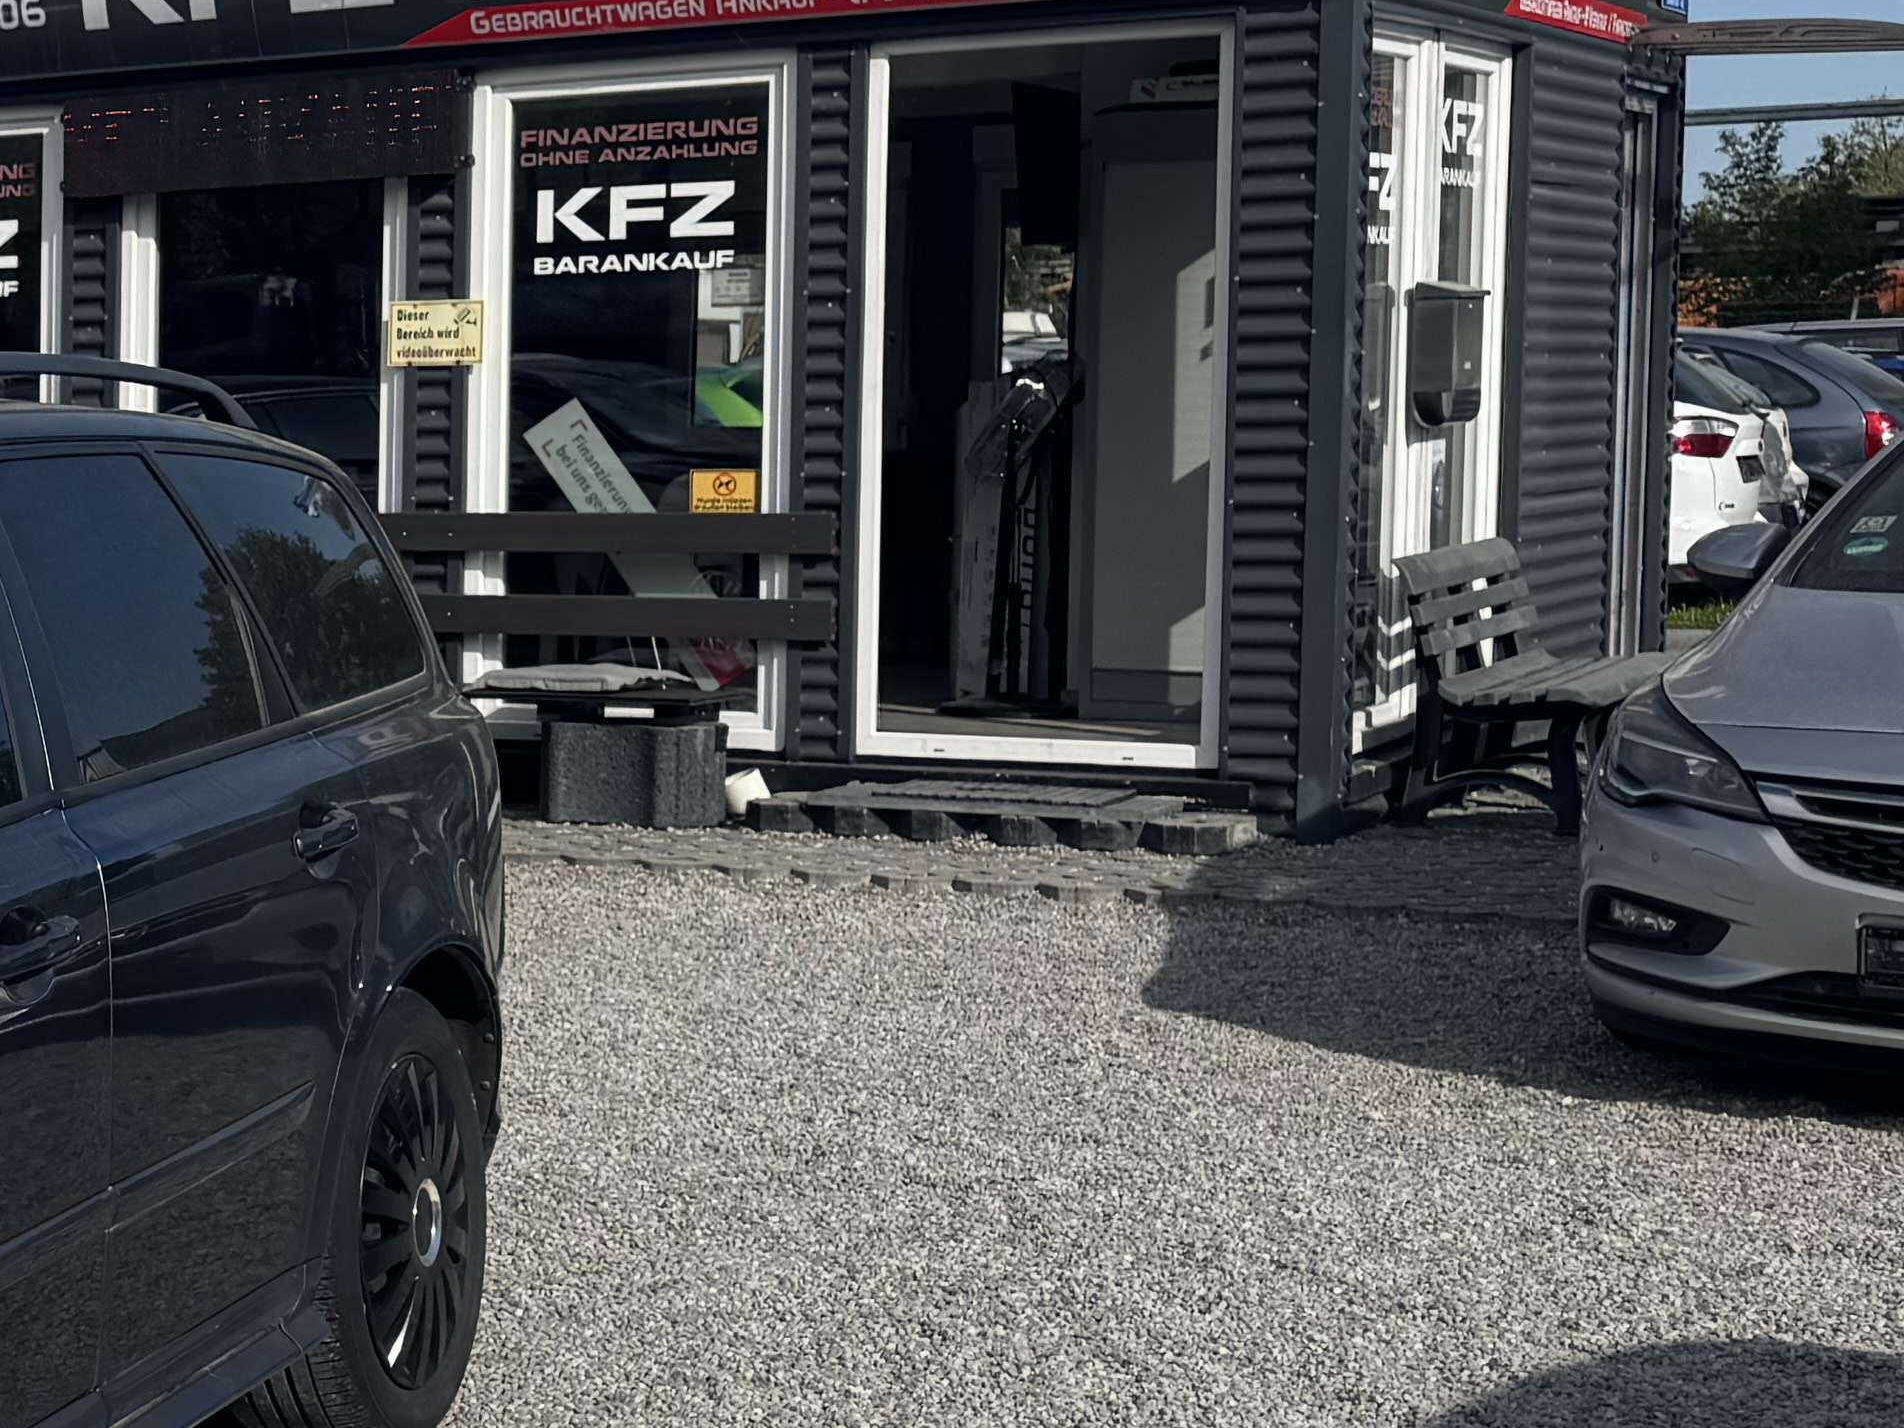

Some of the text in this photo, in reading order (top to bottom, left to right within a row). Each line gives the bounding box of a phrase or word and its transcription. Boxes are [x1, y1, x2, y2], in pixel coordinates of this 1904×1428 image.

[520, 116, 759, 149] FINANZIERUNG
[520, 139, 758, 168] OHNE ANZAHLUNG
[536, 180, 735, 243] KFZ
[533, 249, 735, 276] BARANKAUF
[397, 309, 430, 322] Dieser
[396, 325, 460, 340] Bereich wird
[397, 345, 477, 358] videoüberwacht
